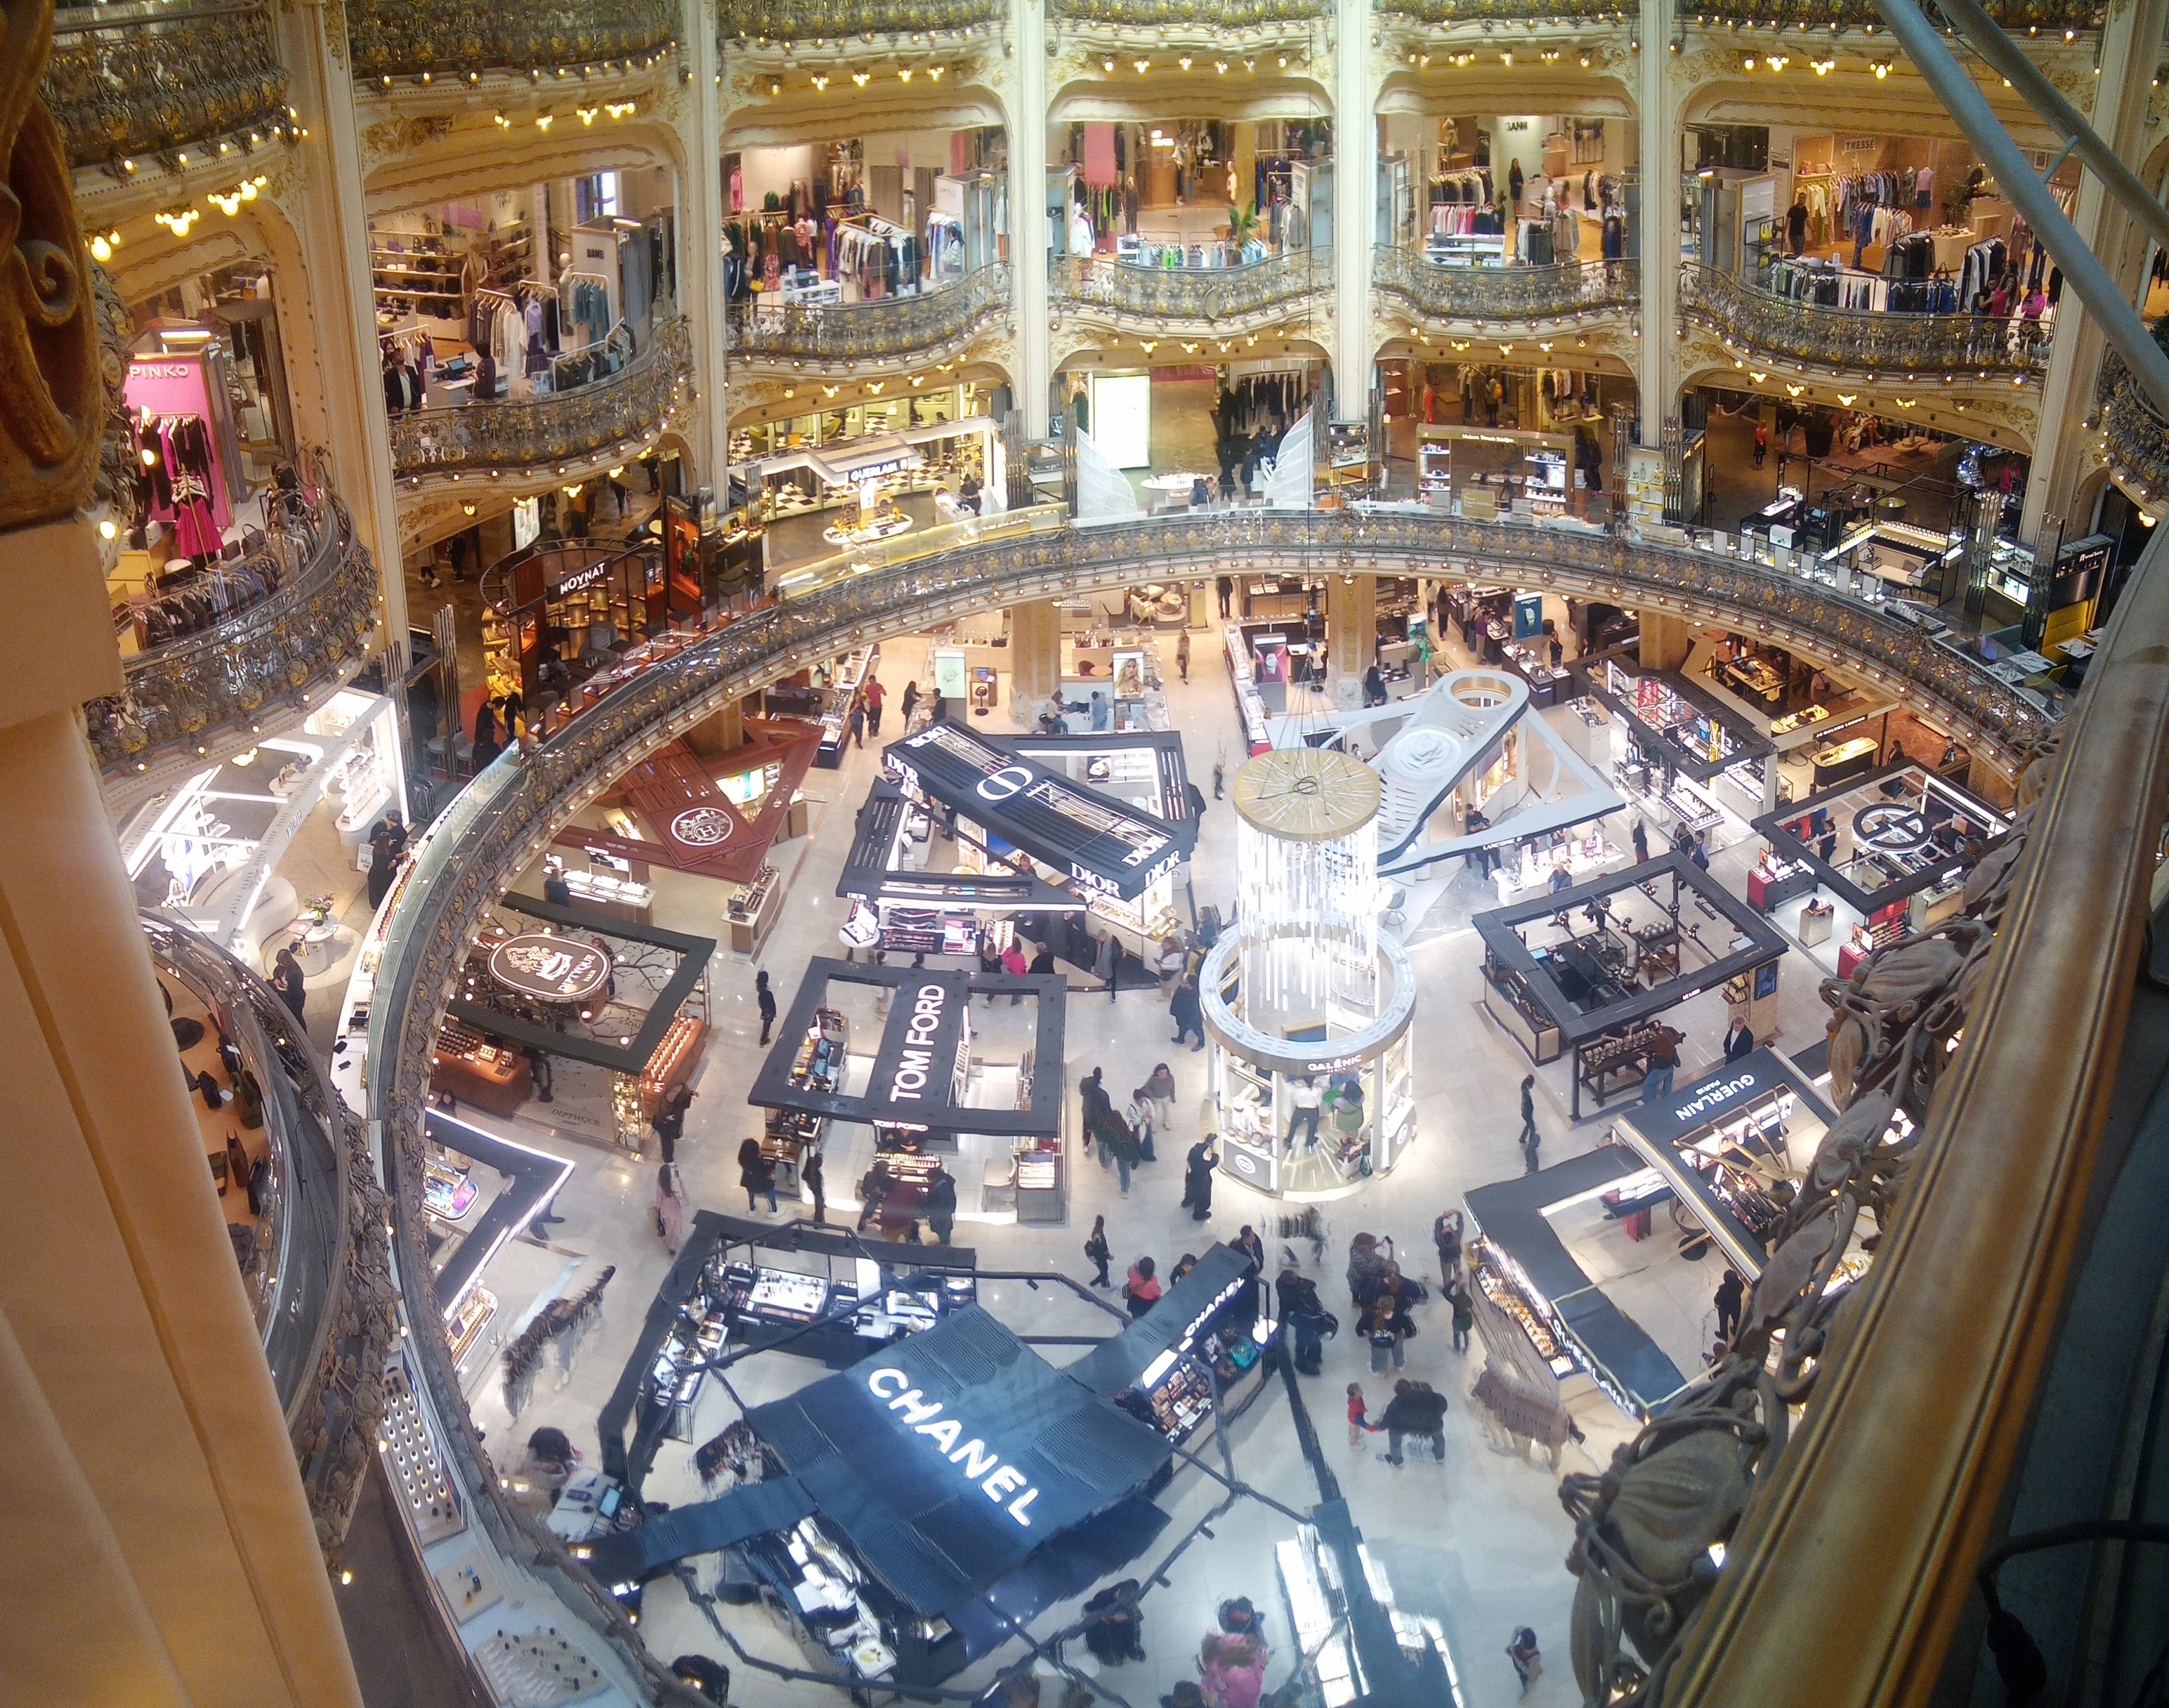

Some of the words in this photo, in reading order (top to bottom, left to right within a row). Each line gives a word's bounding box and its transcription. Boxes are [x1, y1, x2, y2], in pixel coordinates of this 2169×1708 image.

[129, 364, 189, 379] PINKO
[850, 461, 898, 482] GUERLAIN
[560, 563, 606, 596] MOYNAT
[903, 725, 950, 749] DIOR
[886, 752, 920, 787] DIOR
[286, 809, 303, 839] DIOR
[1120, 834, 1170, 867] DIOR
[1070, 861, 1122, 898] DIOR
[1144, 850, 1181, 888] DIOR
[557, 953, 597, 993] DIPTYQUE
[905, 983, 946, 1046] FORD
[890, 1049, 932, 1102] TOM
[1695, 1079, 1722, 1096] PARIS
[1675, 1074, 1755, 1121] GUERLAIN
[1184, 1277, 1245, 1337] CHANEL
[868, 1367, 1040, 1528] CHANEL
